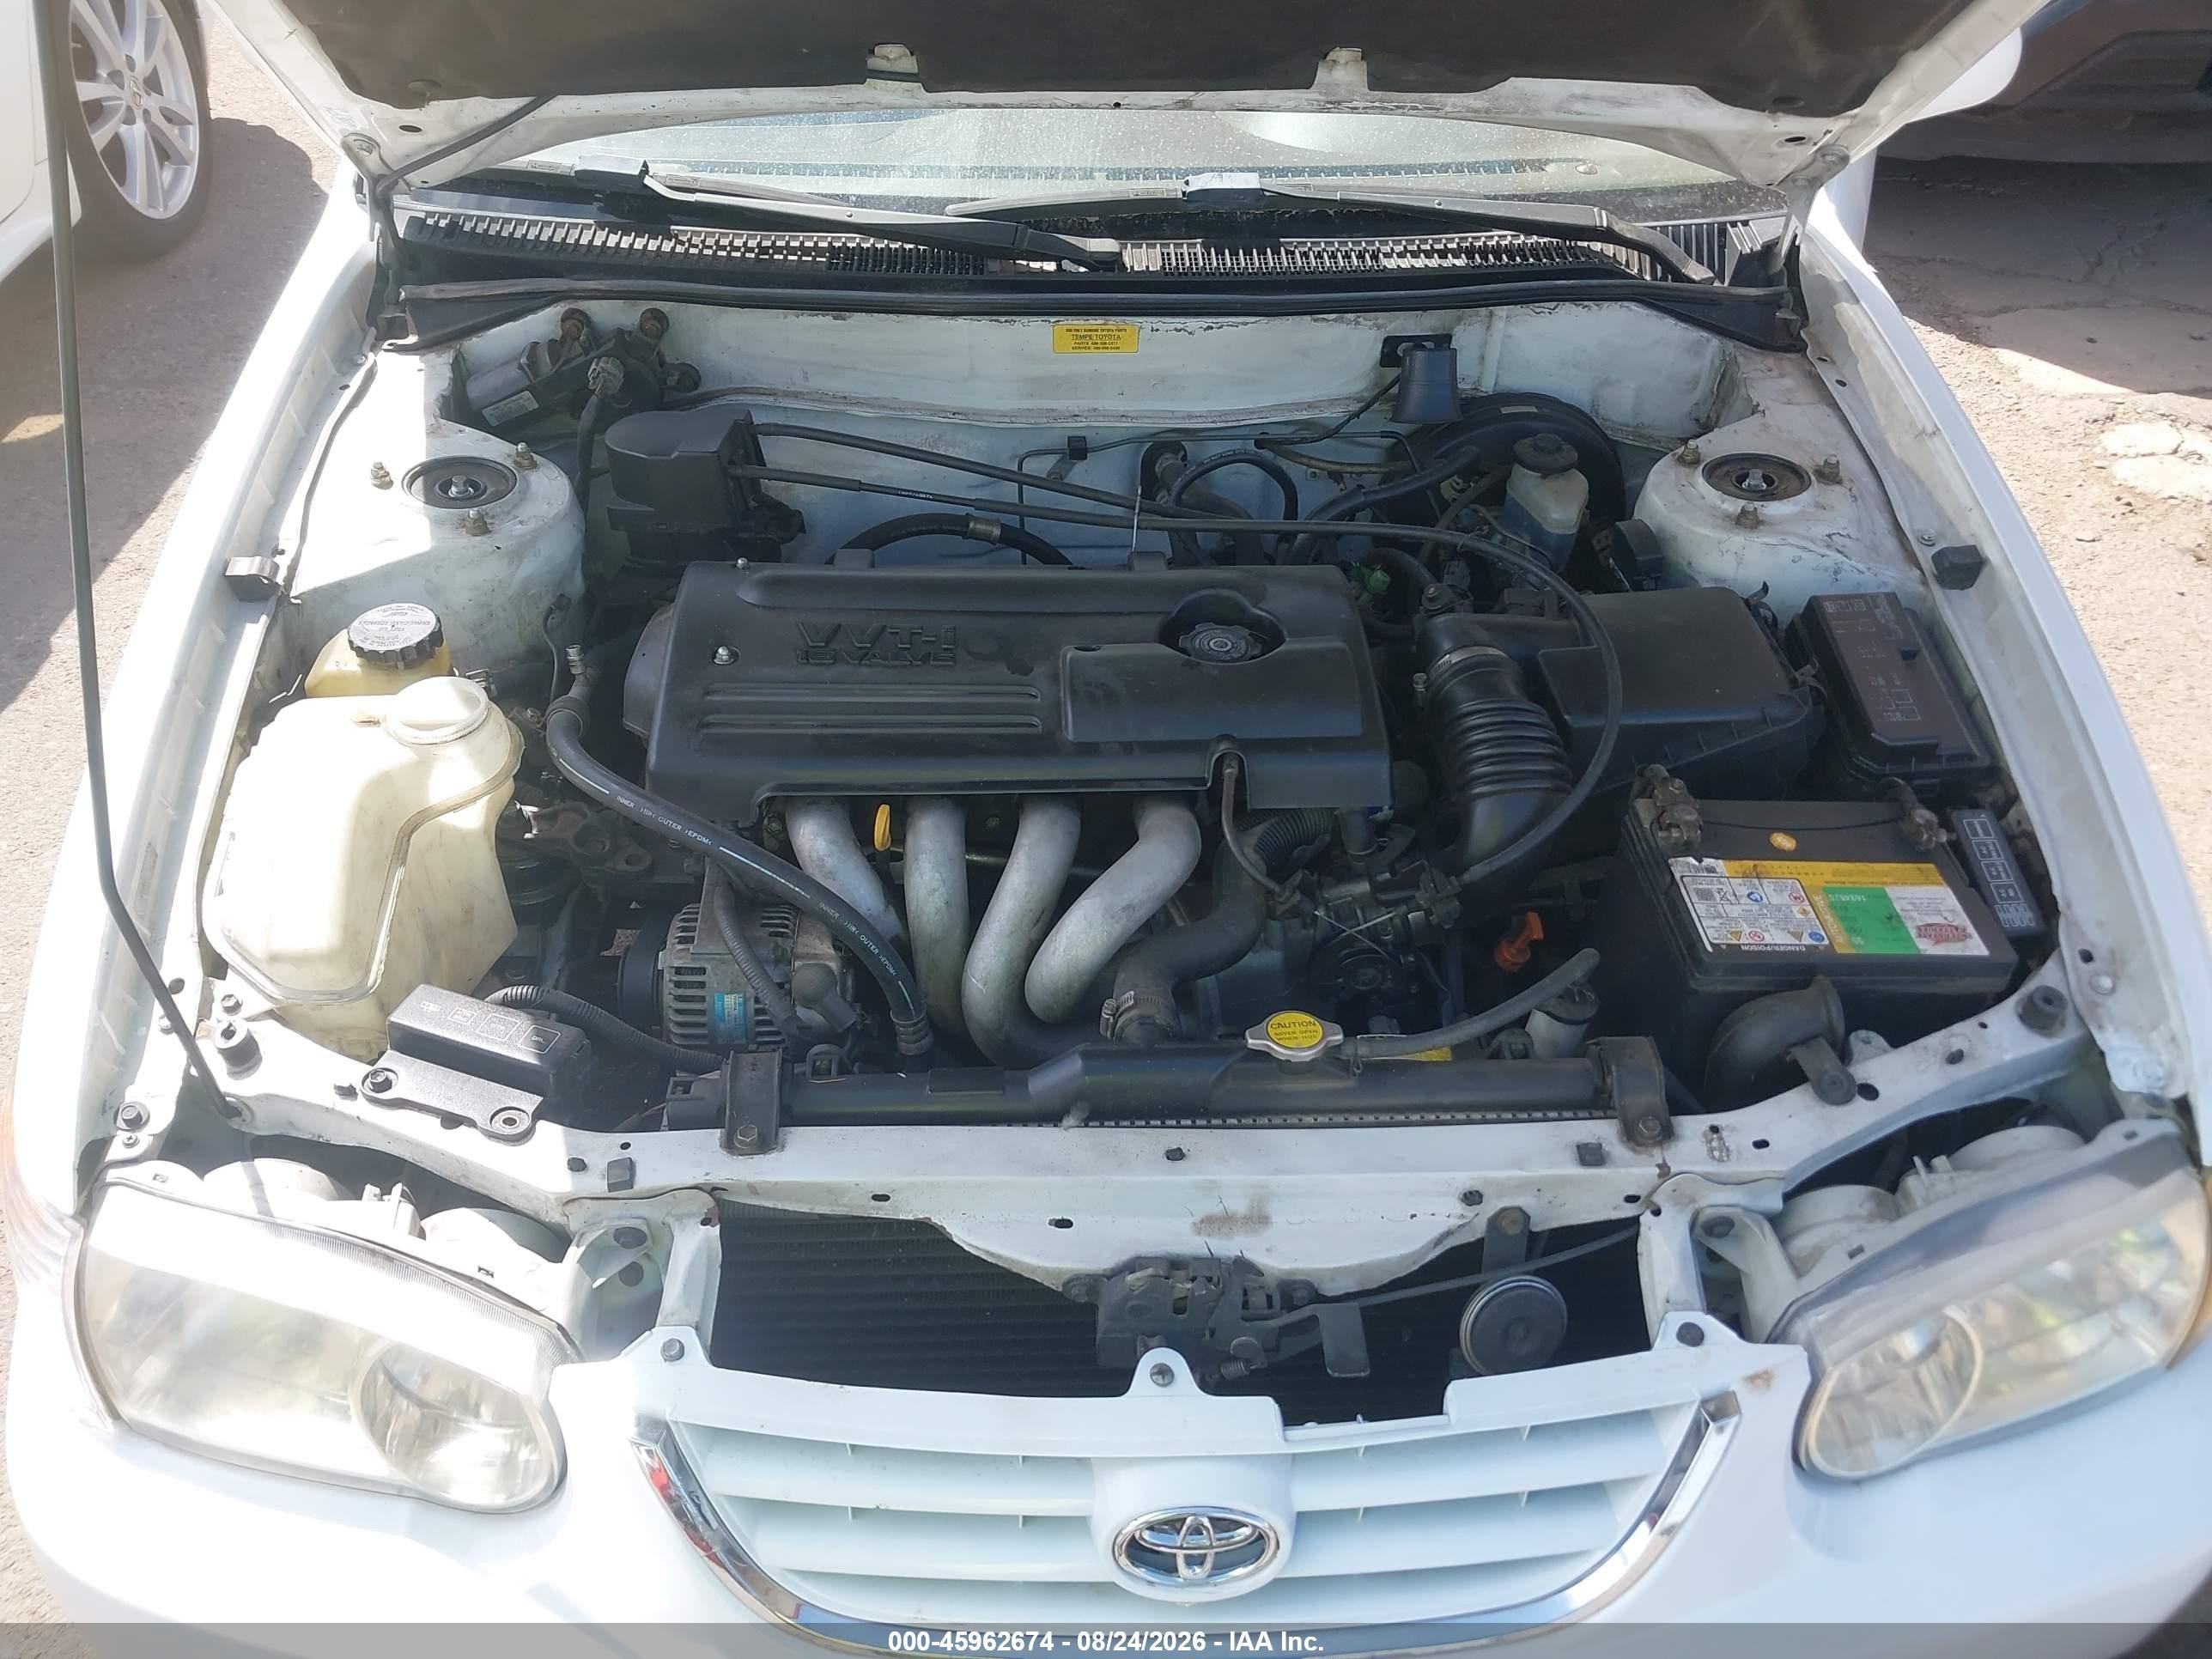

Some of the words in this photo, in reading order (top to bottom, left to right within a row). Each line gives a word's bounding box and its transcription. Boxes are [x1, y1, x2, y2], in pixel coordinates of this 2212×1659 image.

[843, 649, 956, 665] VALVE
[617, 795, 635, 809] INNER
[658, 816, 682, 831] OUTER
[818, 901, 840, 920] INNER
[860, 934, 879, 955] OUTER
[1270, 1020, 1316, 1030] CAUTION
